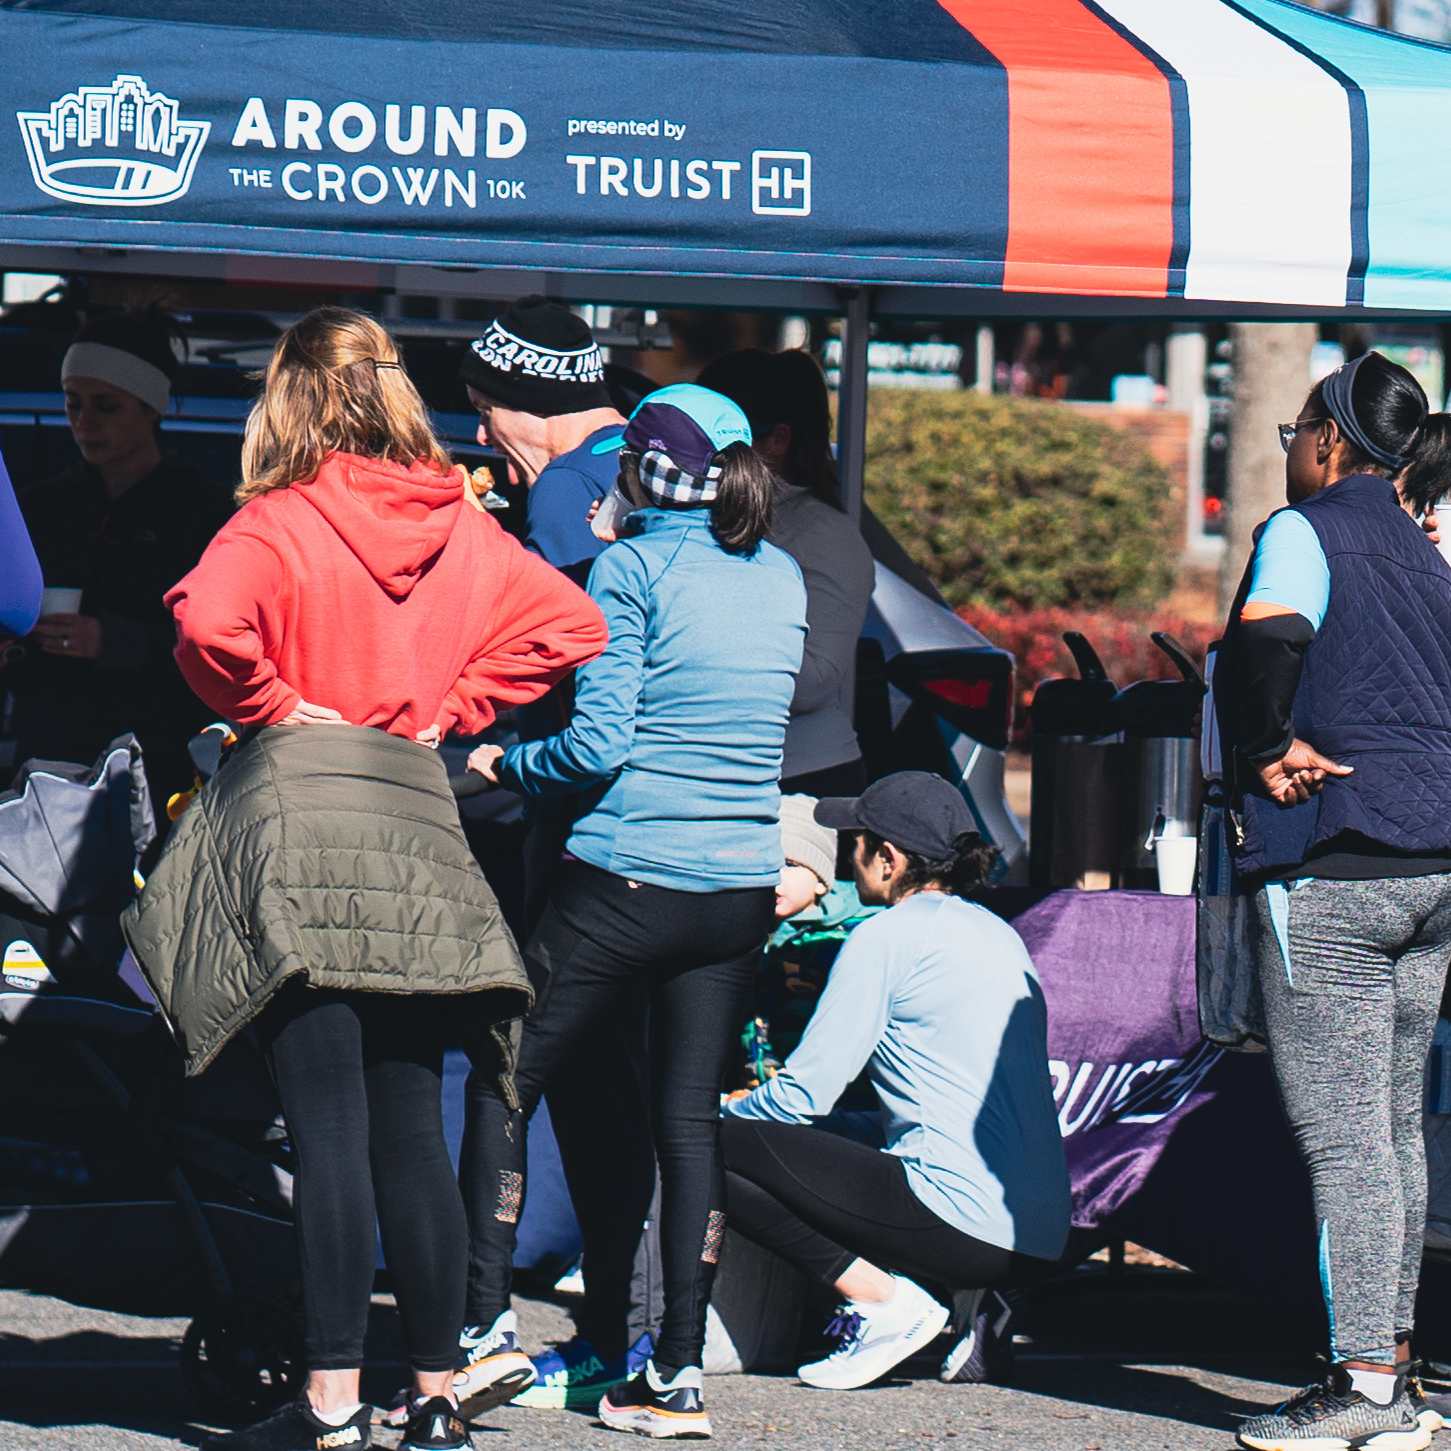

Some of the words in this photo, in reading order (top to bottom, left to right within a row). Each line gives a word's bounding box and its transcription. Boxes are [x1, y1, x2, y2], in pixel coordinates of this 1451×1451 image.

[230, 96, 528, 160] AROUND
[567, 117, 660, 140] presented
[664, 117, 688, 141] by
[228, 167, 273, 188] THE
[281, 161, 478, 209] CROWN
[486, 178, 527, 200] 10K
[566, 154, 742, 201] TRUIST
[544, 1356, 605, 1388] HOKA
[316, 1425, 362, 1450] HOKA
